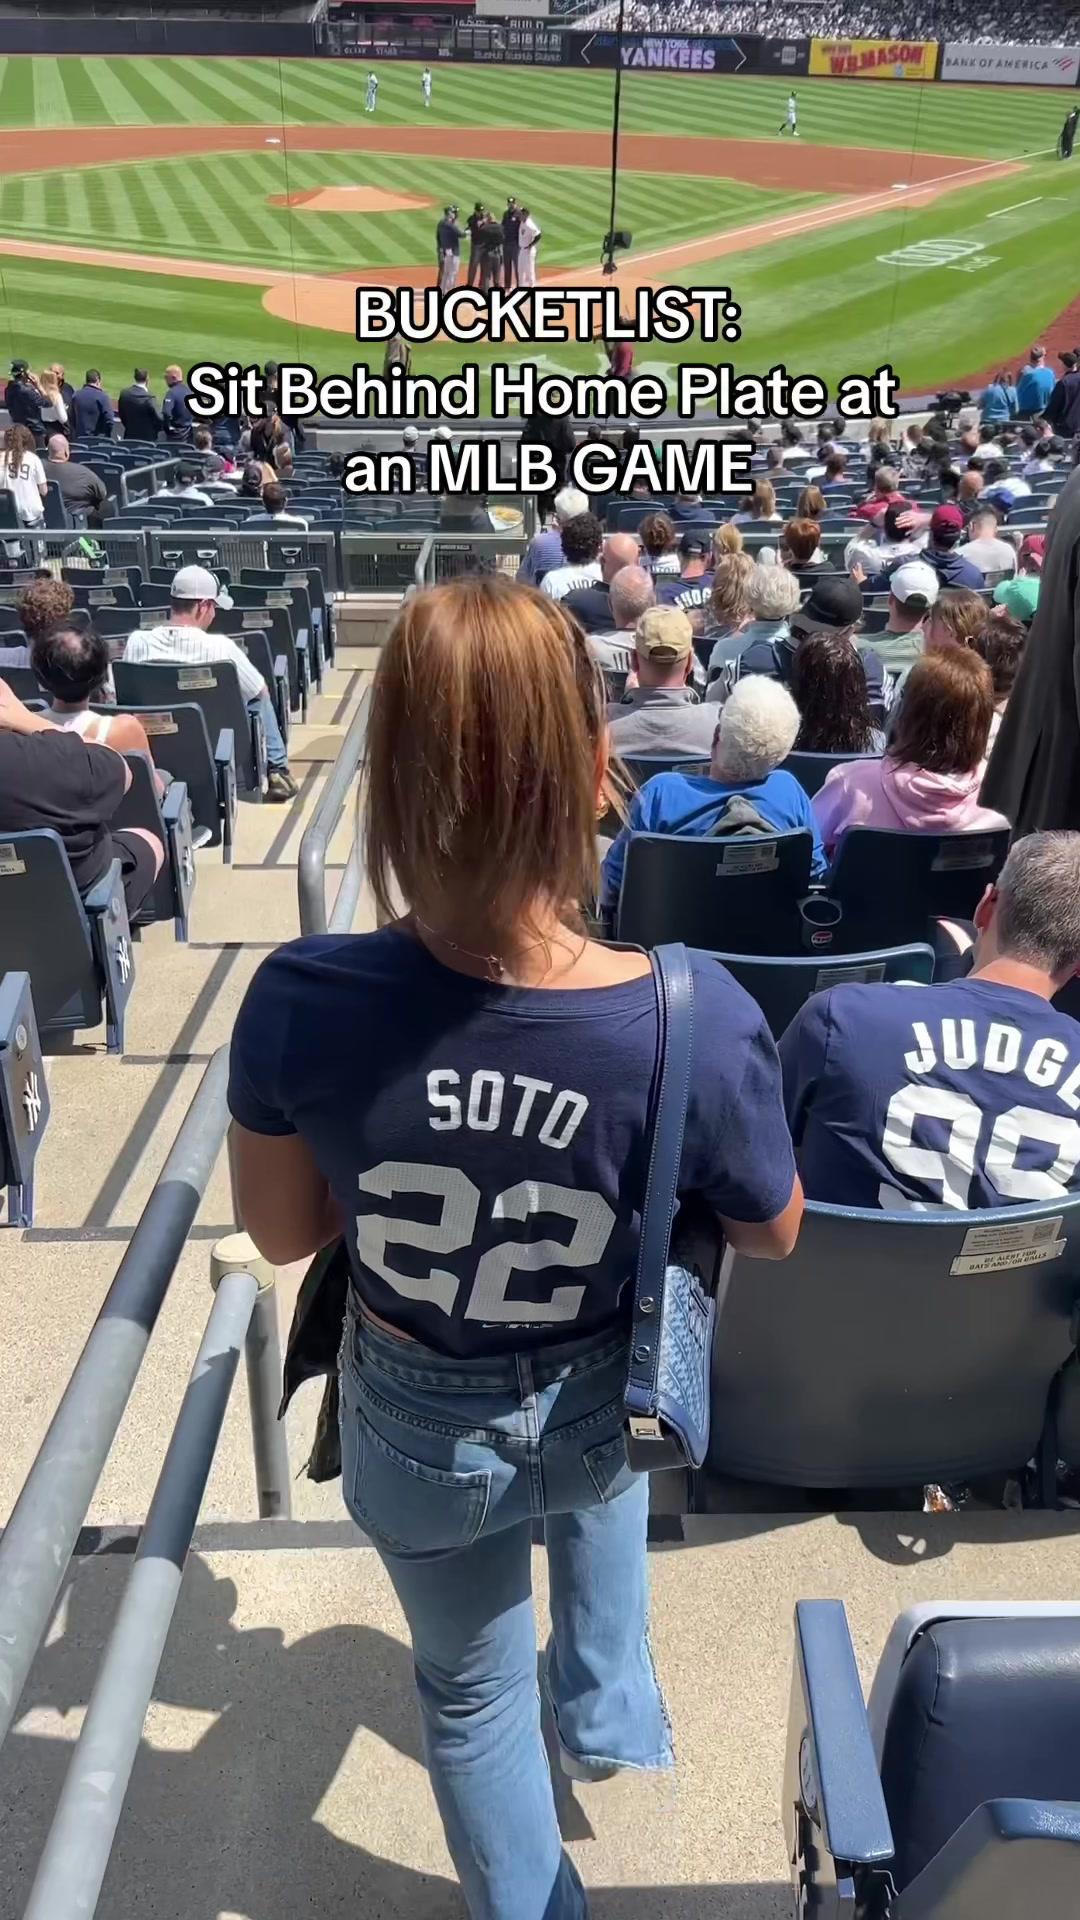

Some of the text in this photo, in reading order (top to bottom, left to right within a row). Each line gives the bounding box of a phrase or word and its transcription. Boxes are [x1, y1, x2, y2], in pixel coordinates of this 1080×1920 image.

[664, 39, 689, 49] YORK
[621, 47, 716, 70] YANKEES
[945, 58, 1049, 70] BANK OF AMERICA
[426, 1068, 590, 1150] SOTO
[356, 1160, 617, 1322] 22
[969, 1262, 991, 1270] BATS
[1024, 1251, 1047, 1262] BALLS
[997, 1252, 1021, 1262] ALERT
[1022, 1249, 1037, 1257] FOR
